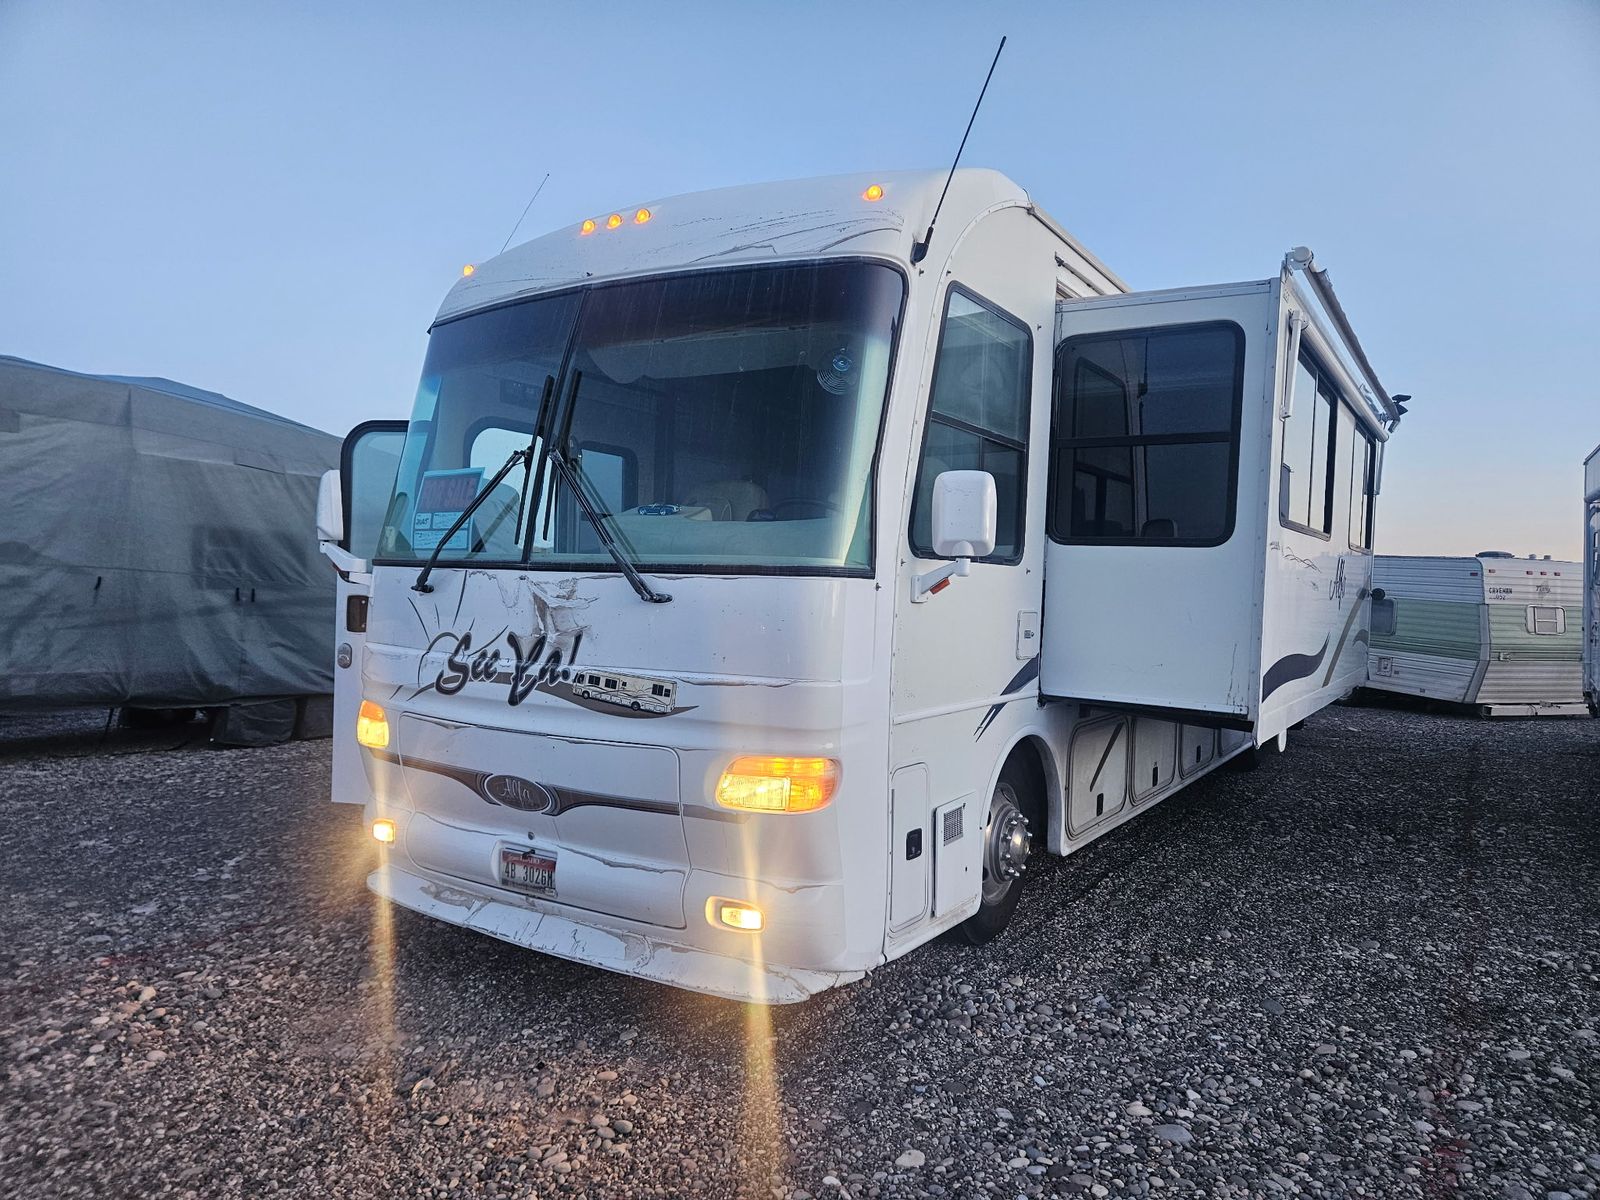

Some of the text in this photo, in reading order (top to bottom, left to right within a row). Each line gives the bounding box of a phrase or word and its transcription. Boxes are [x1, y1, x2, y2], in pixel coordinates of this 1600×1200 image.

[435, 630, 584, 707] See Ya!
[504, 862, 516, 879] 4B
